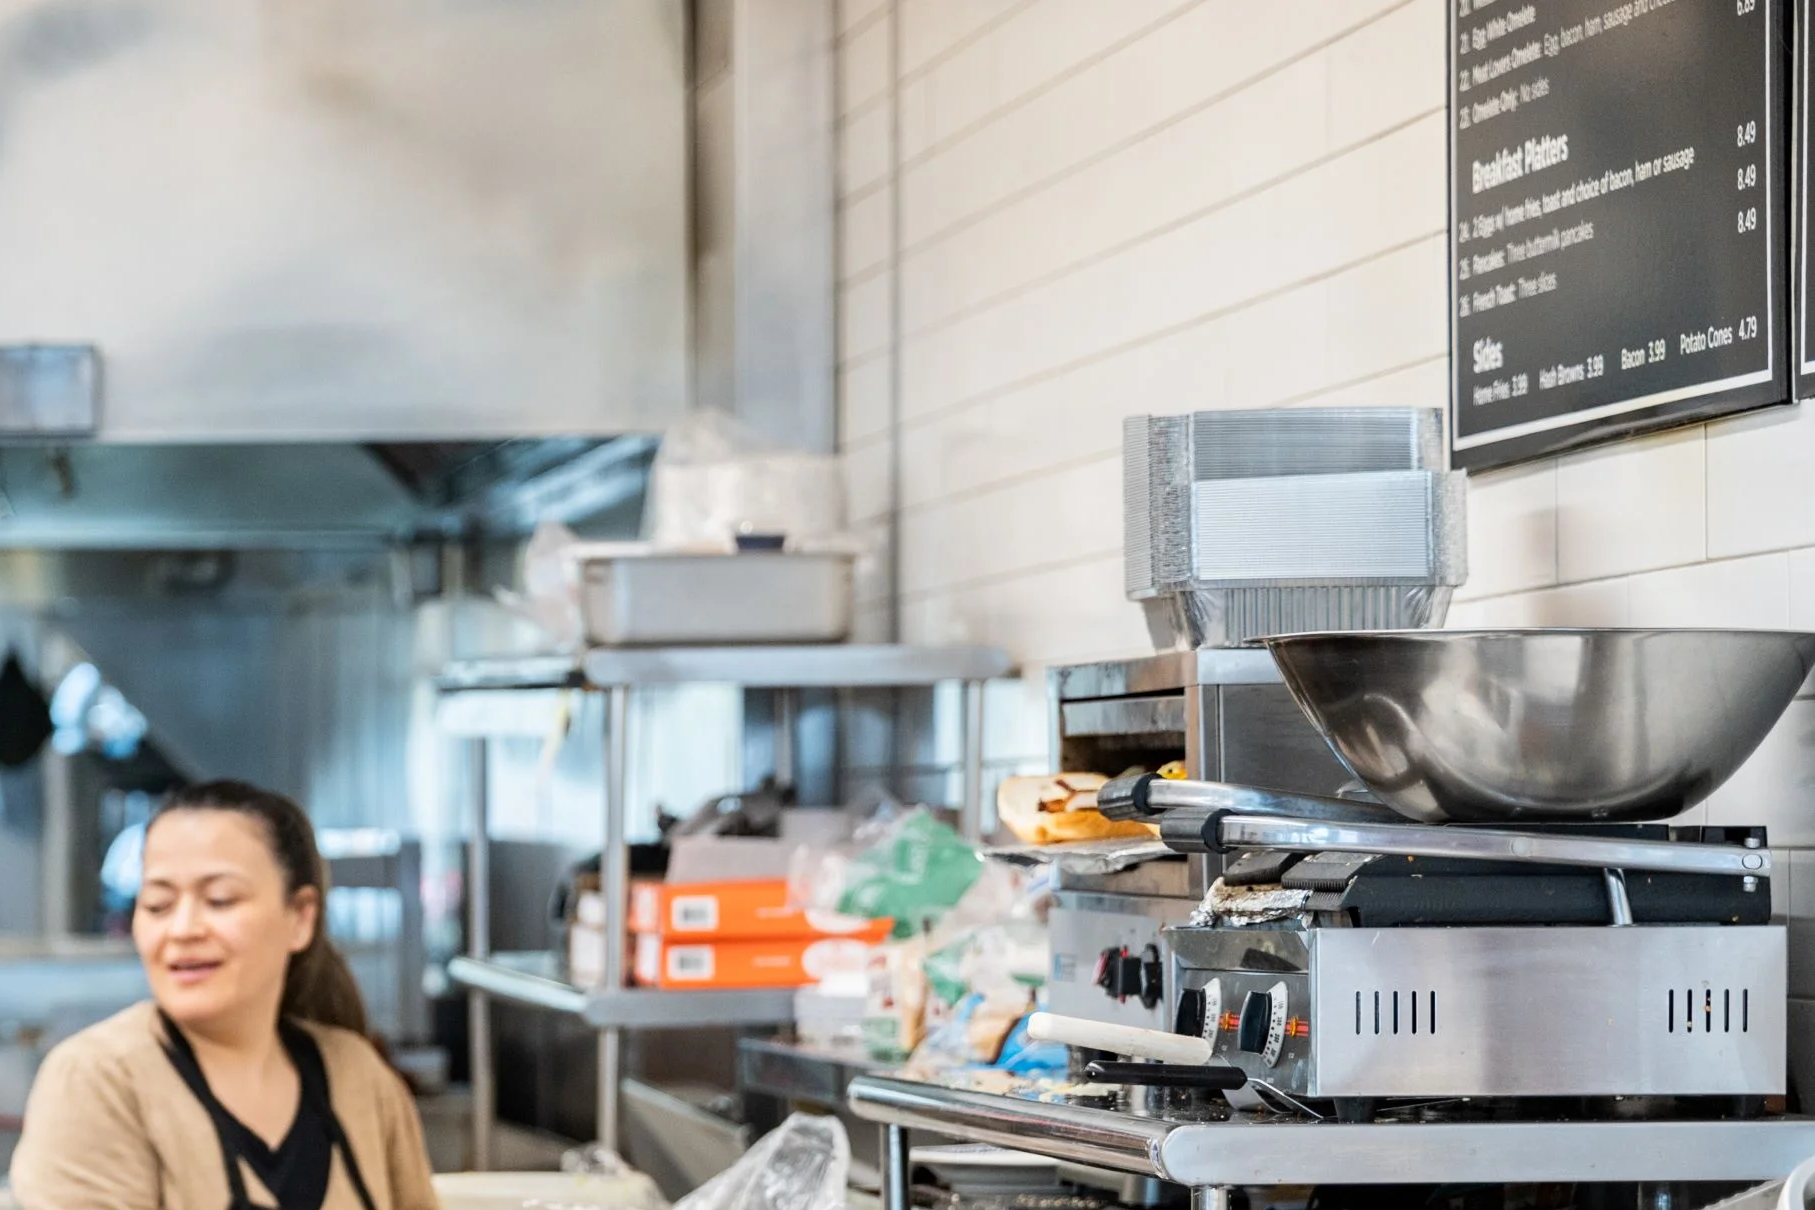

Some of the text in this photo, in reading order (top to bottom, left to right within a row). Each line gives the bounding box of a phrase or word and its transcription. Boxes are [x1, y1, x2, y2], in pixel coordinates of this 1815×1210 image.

[1603, 3, 1633, 30] sausage
[1472, 134, 1568, 194] Breakfast Platters
[1561, 182, 1575, 207] and
[1576, 177, 1599, 202] choice
[1600, 169, 1609, 194] of
[1609, 168, 1634, 191] bacon,
[1635, 160, 1651, 182] ham
[1653, 157, 1662, 176] or
[1663, 146, 1695, 172] sausage
[1737, 120, 1756, 147] 8.49
[1560, 220, 1594, 250] pancakes
[1737, 164, 1756, 191] 8.49
[1737, 207, 1757, 234] 8.49
[1473, 337, 1503, 374] Sides
[1512, 373, 1529, 397] 3.99
[1558, 362, 1585, 385] Browns
[1586, 355, 1604, 379] 3.99
[1621, 348, 1645, 370] Bacon
[1648, 339, 1666, 364] 3.99
[1680, 333, 1706, 355] Potato
[1708, 325, 1733, 349] Cones
[1738, 316, 1757, 341] 4.79
